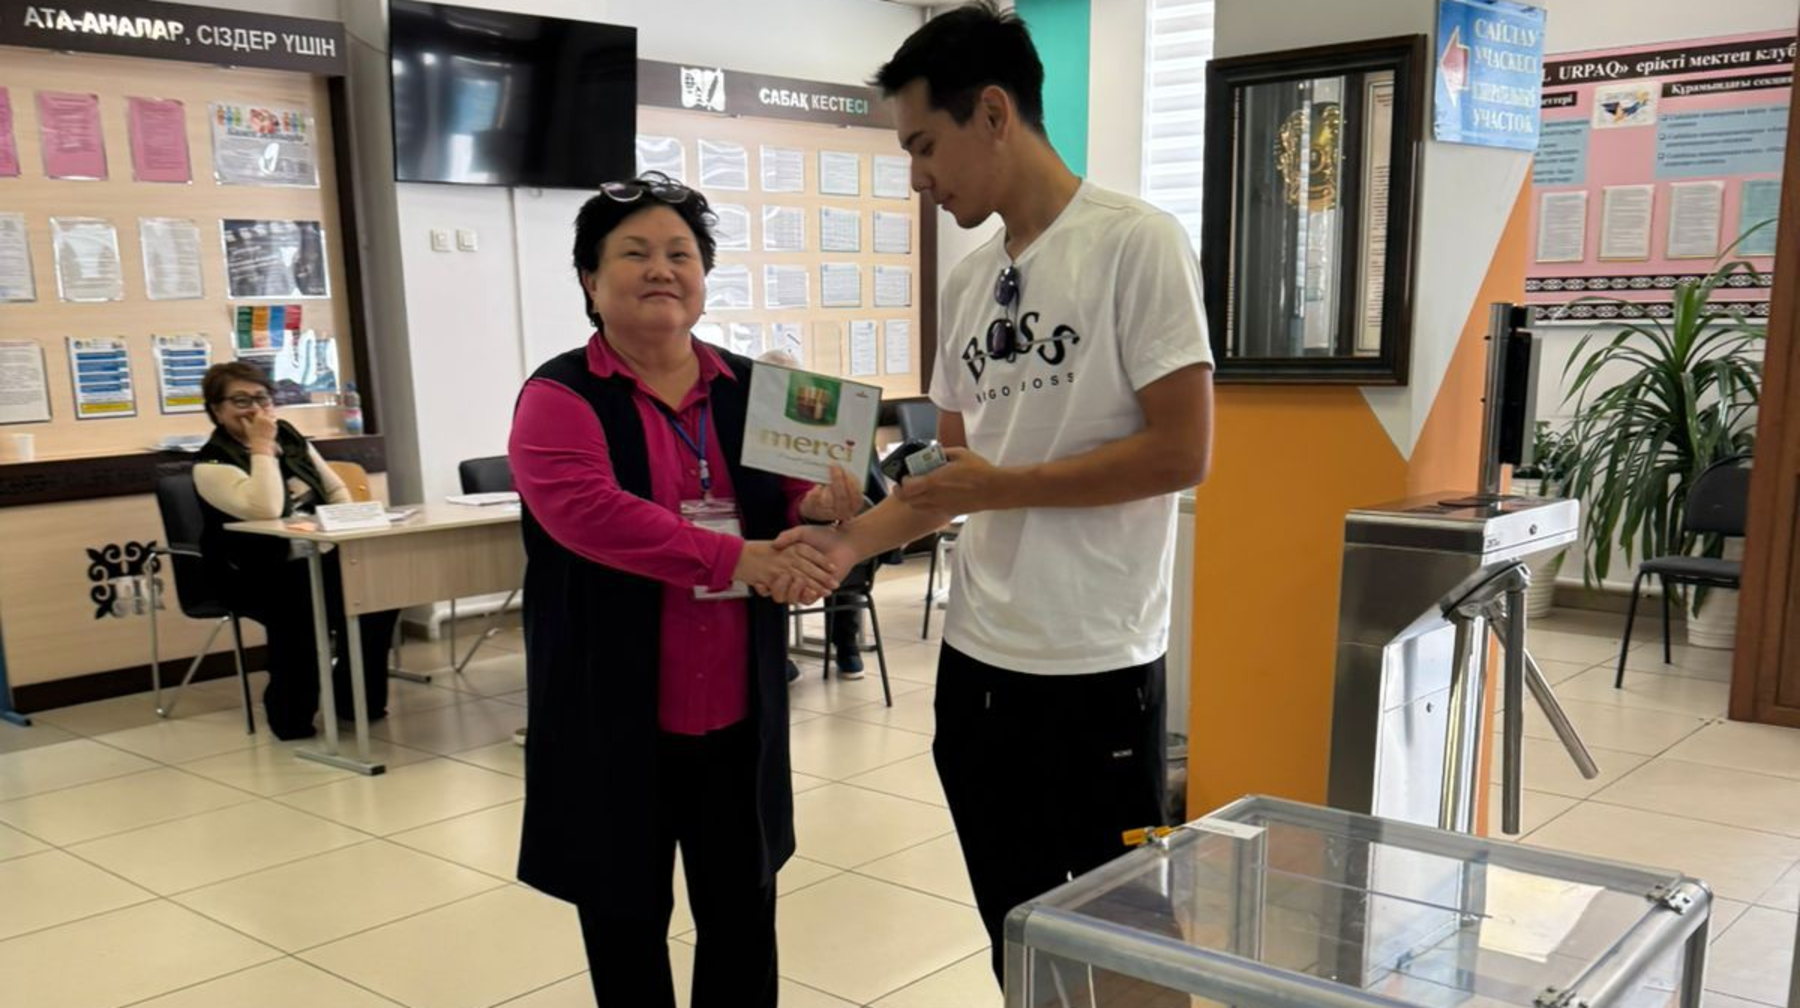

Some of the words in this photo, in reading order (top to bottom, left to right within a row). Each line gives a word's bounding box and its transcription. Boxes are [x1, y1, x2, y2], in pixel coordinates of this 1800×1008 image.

[24, 6, 191, 45] АТА-АНАЛАР,
[197, 25, 277, 52] СІЗДЕР
[282, 33, 336, 57] ҮШІН
[1559, 60, 1629, 80] URPAQ»
[1636, 54, 1686, 75] ерікті
[1689, 49, 1751, 67] мектеп
[759, 88, 809, 111] САБАҚ
[811, 94, 869, 115] КЕСТЕСІ
[760, 428, 853, 463] merci
